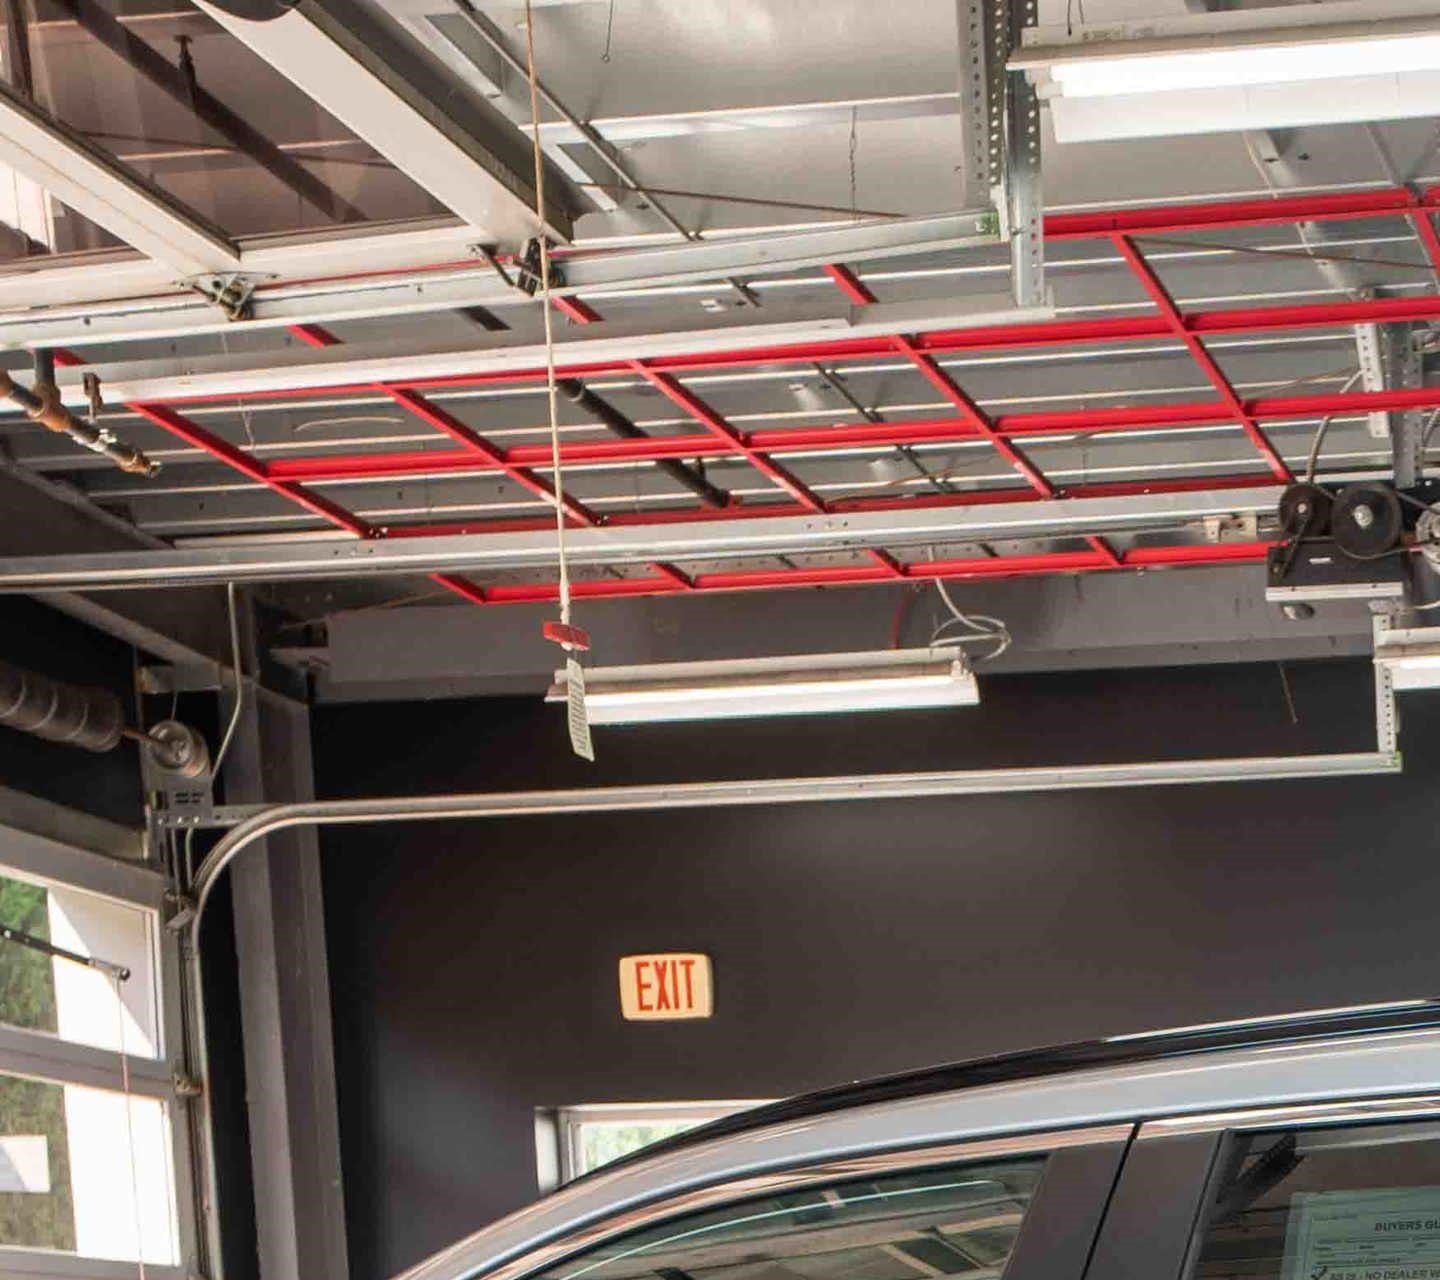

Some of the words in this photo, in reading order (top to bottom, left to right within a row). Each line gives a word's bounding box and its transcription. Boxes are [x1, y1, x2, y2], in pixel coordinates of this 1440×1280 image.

[635, 960, 695, 1011] EXIT
[1374, 1218, 1423, 1232] BUYERS
[1365, 1270, 1382, 1280] NO
[1383, 1269, 1427, 1280] DEALER
